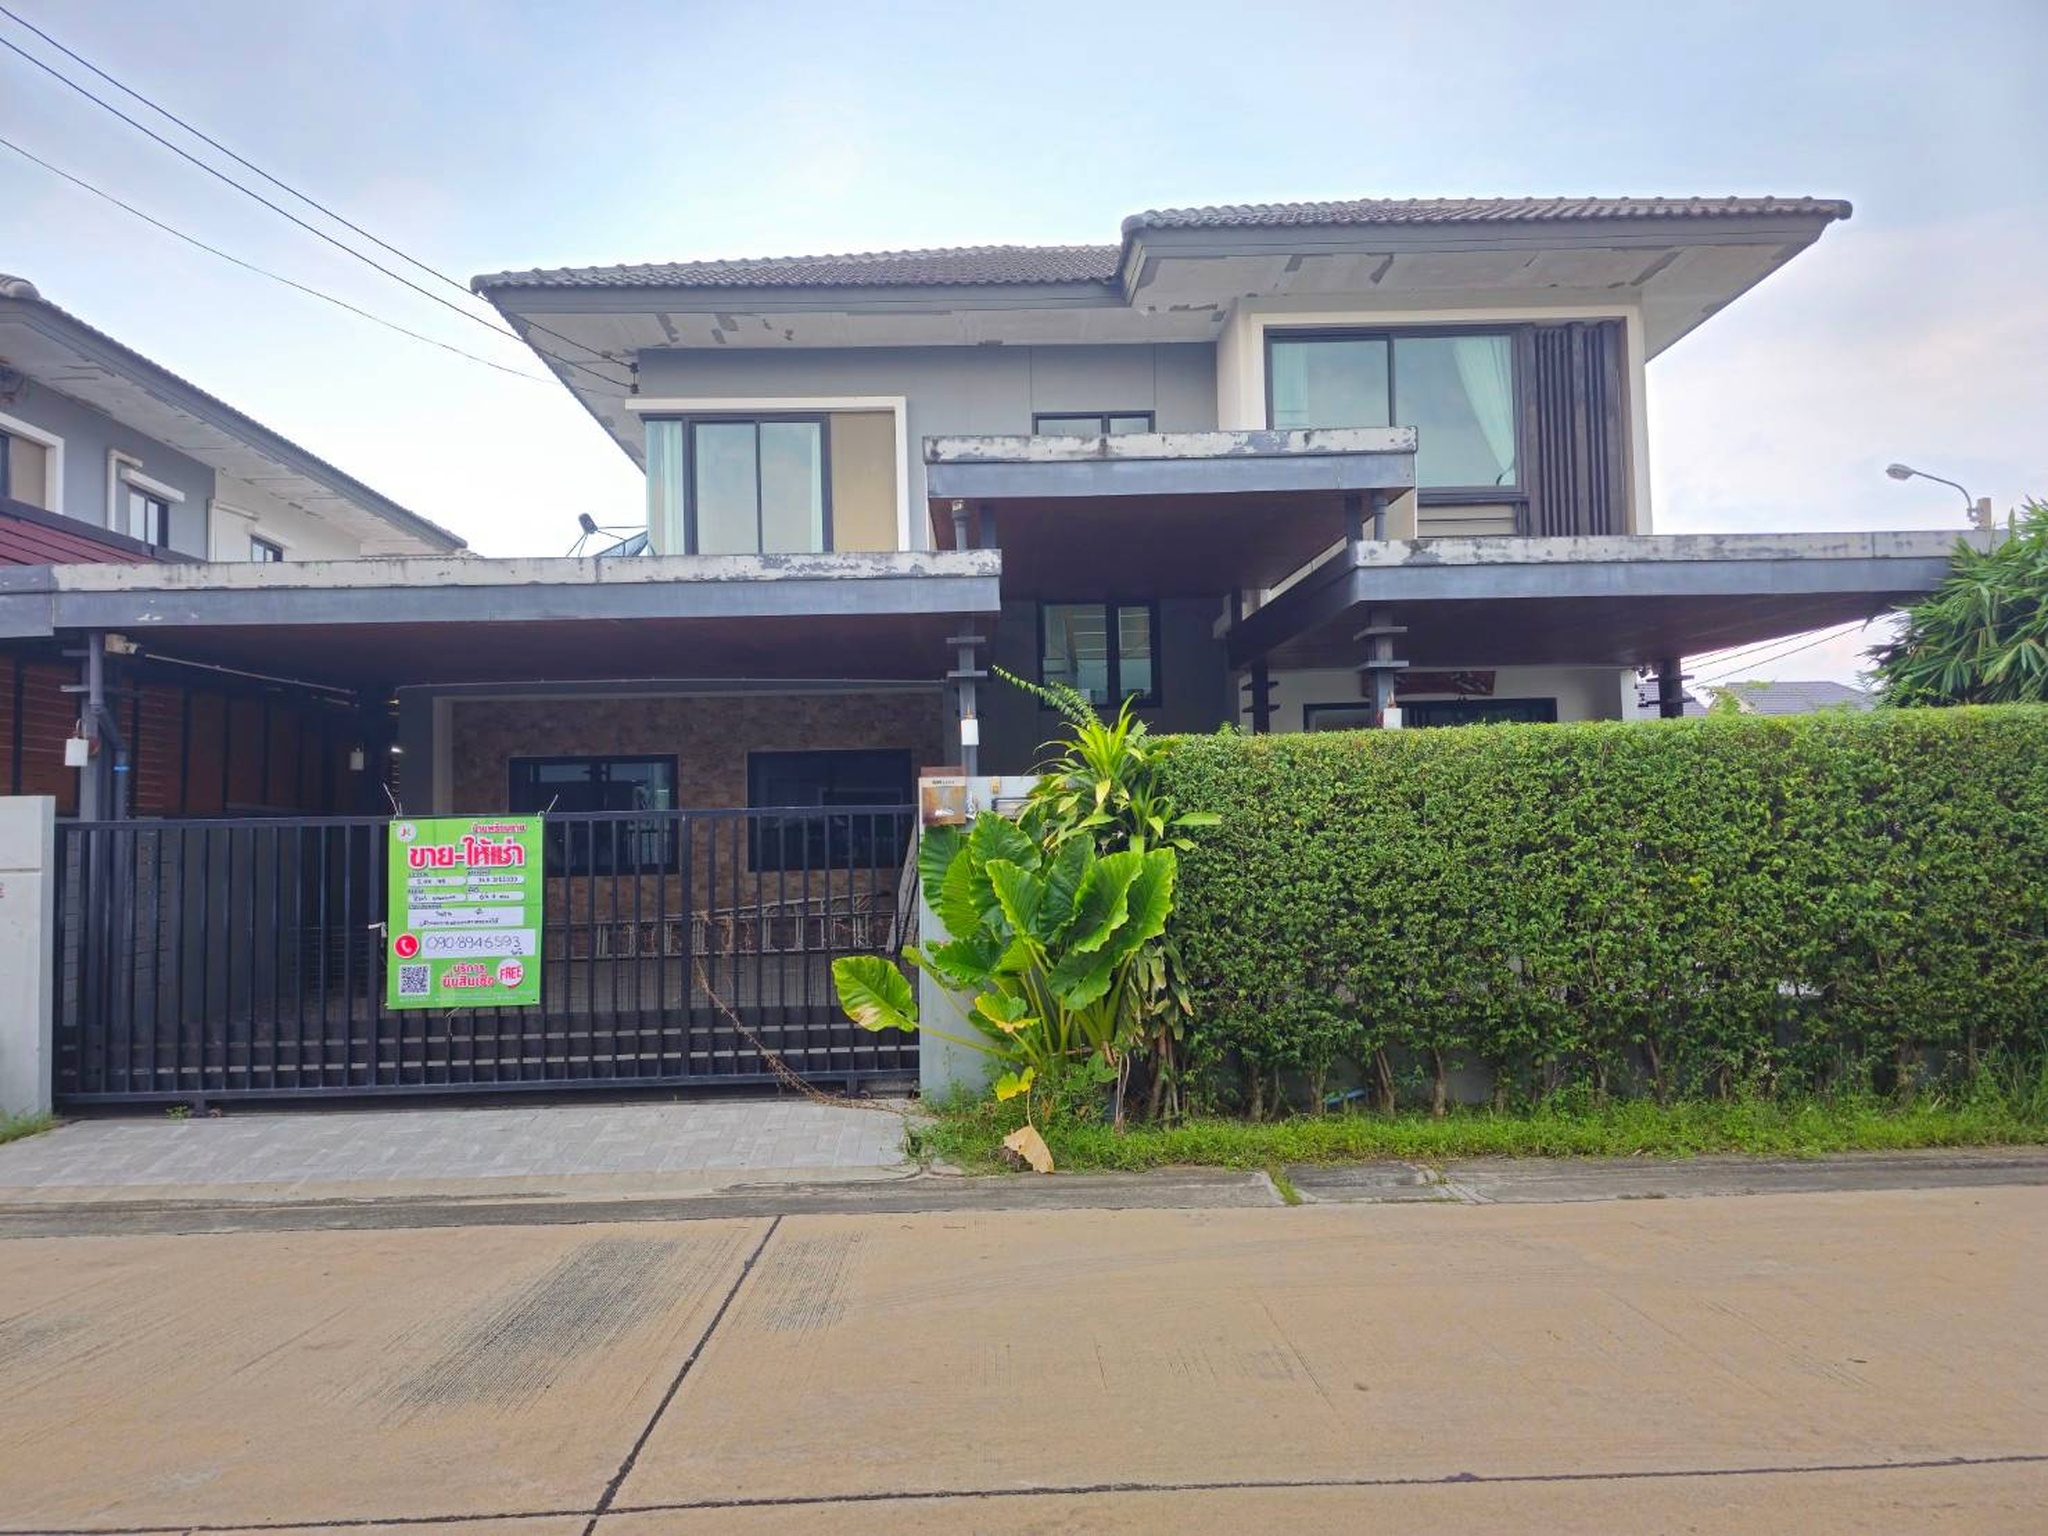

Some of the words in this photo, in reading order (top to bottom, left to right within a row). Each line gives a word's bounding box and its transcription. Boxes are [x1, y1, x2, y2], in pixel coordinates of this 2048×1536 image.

[453, 962, 486, 973] บริการ
[500, 966, 522, 980] FREE
